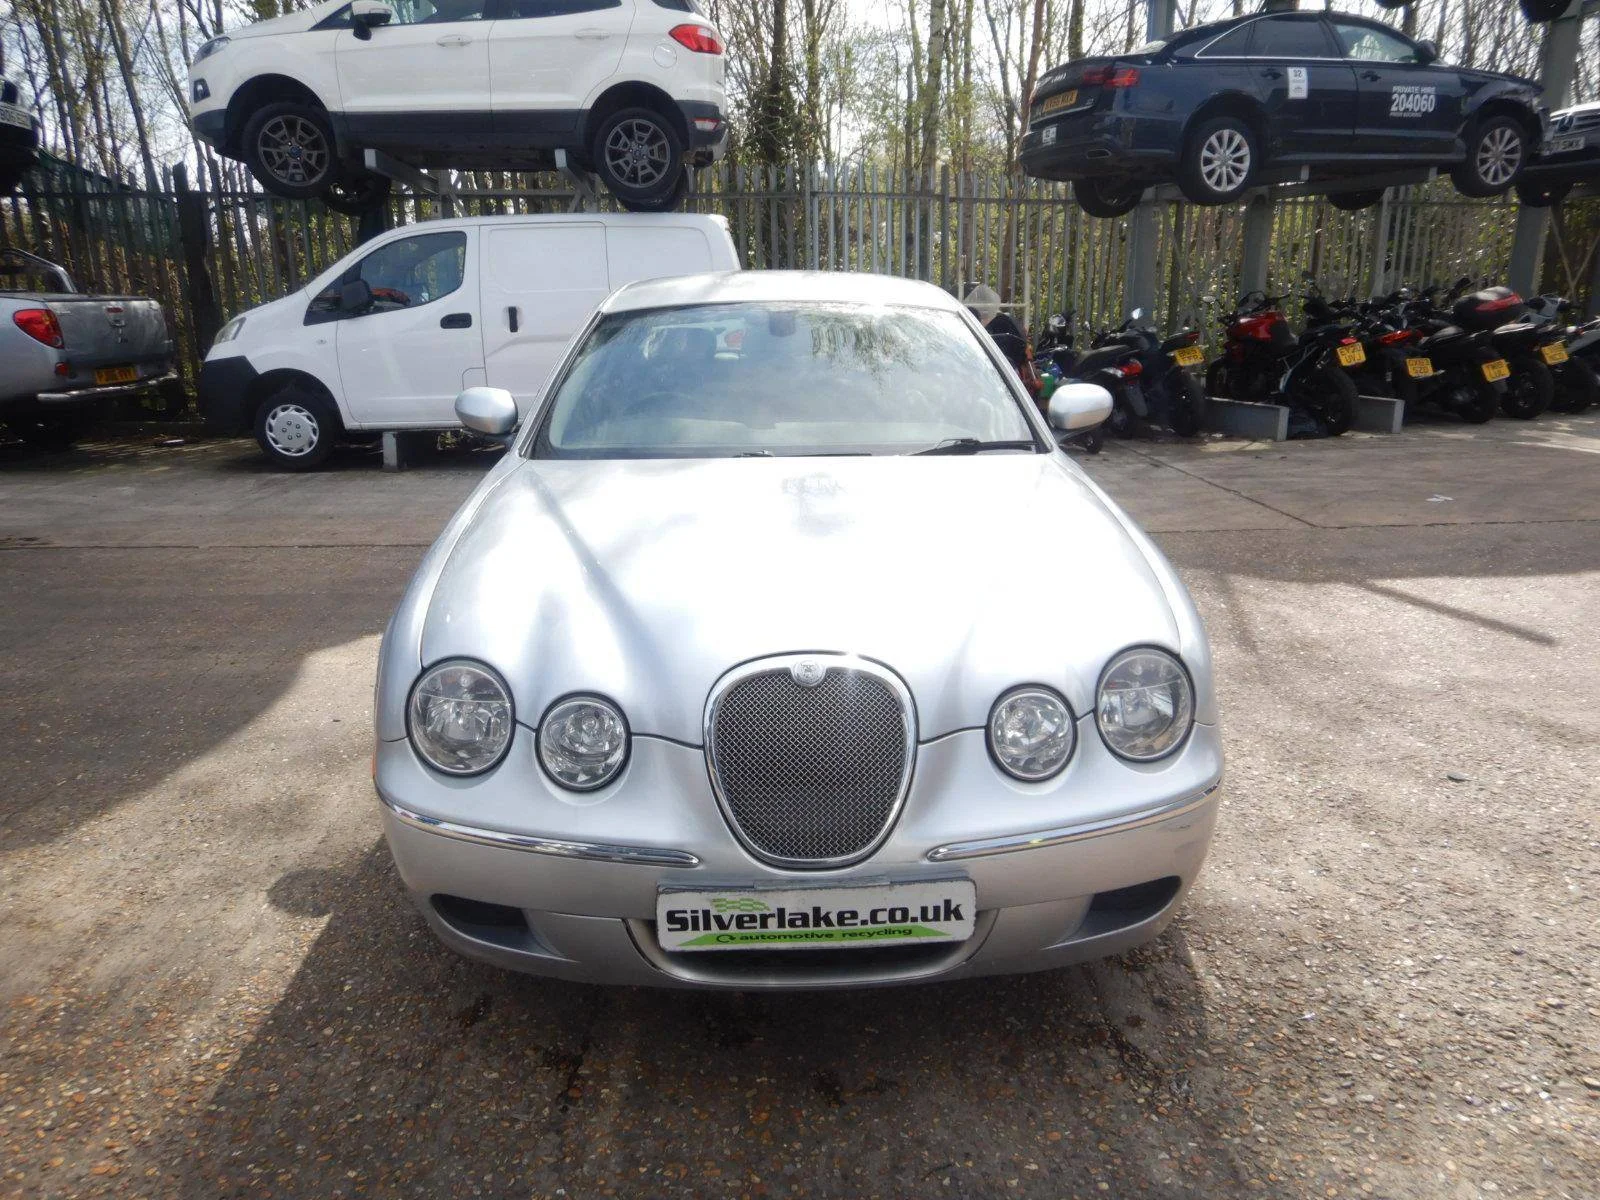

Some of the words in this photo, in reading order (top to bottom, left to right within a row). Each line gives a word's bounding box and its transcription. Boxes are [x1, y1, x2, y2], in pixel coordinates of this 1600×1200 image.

[1390, 93, 1436, 112] 204060
[666, 899, 965, 933] Silverlake.co.uk
[740, 931, 834, 941] automotive
[841, 927, 913, 939] recycling
